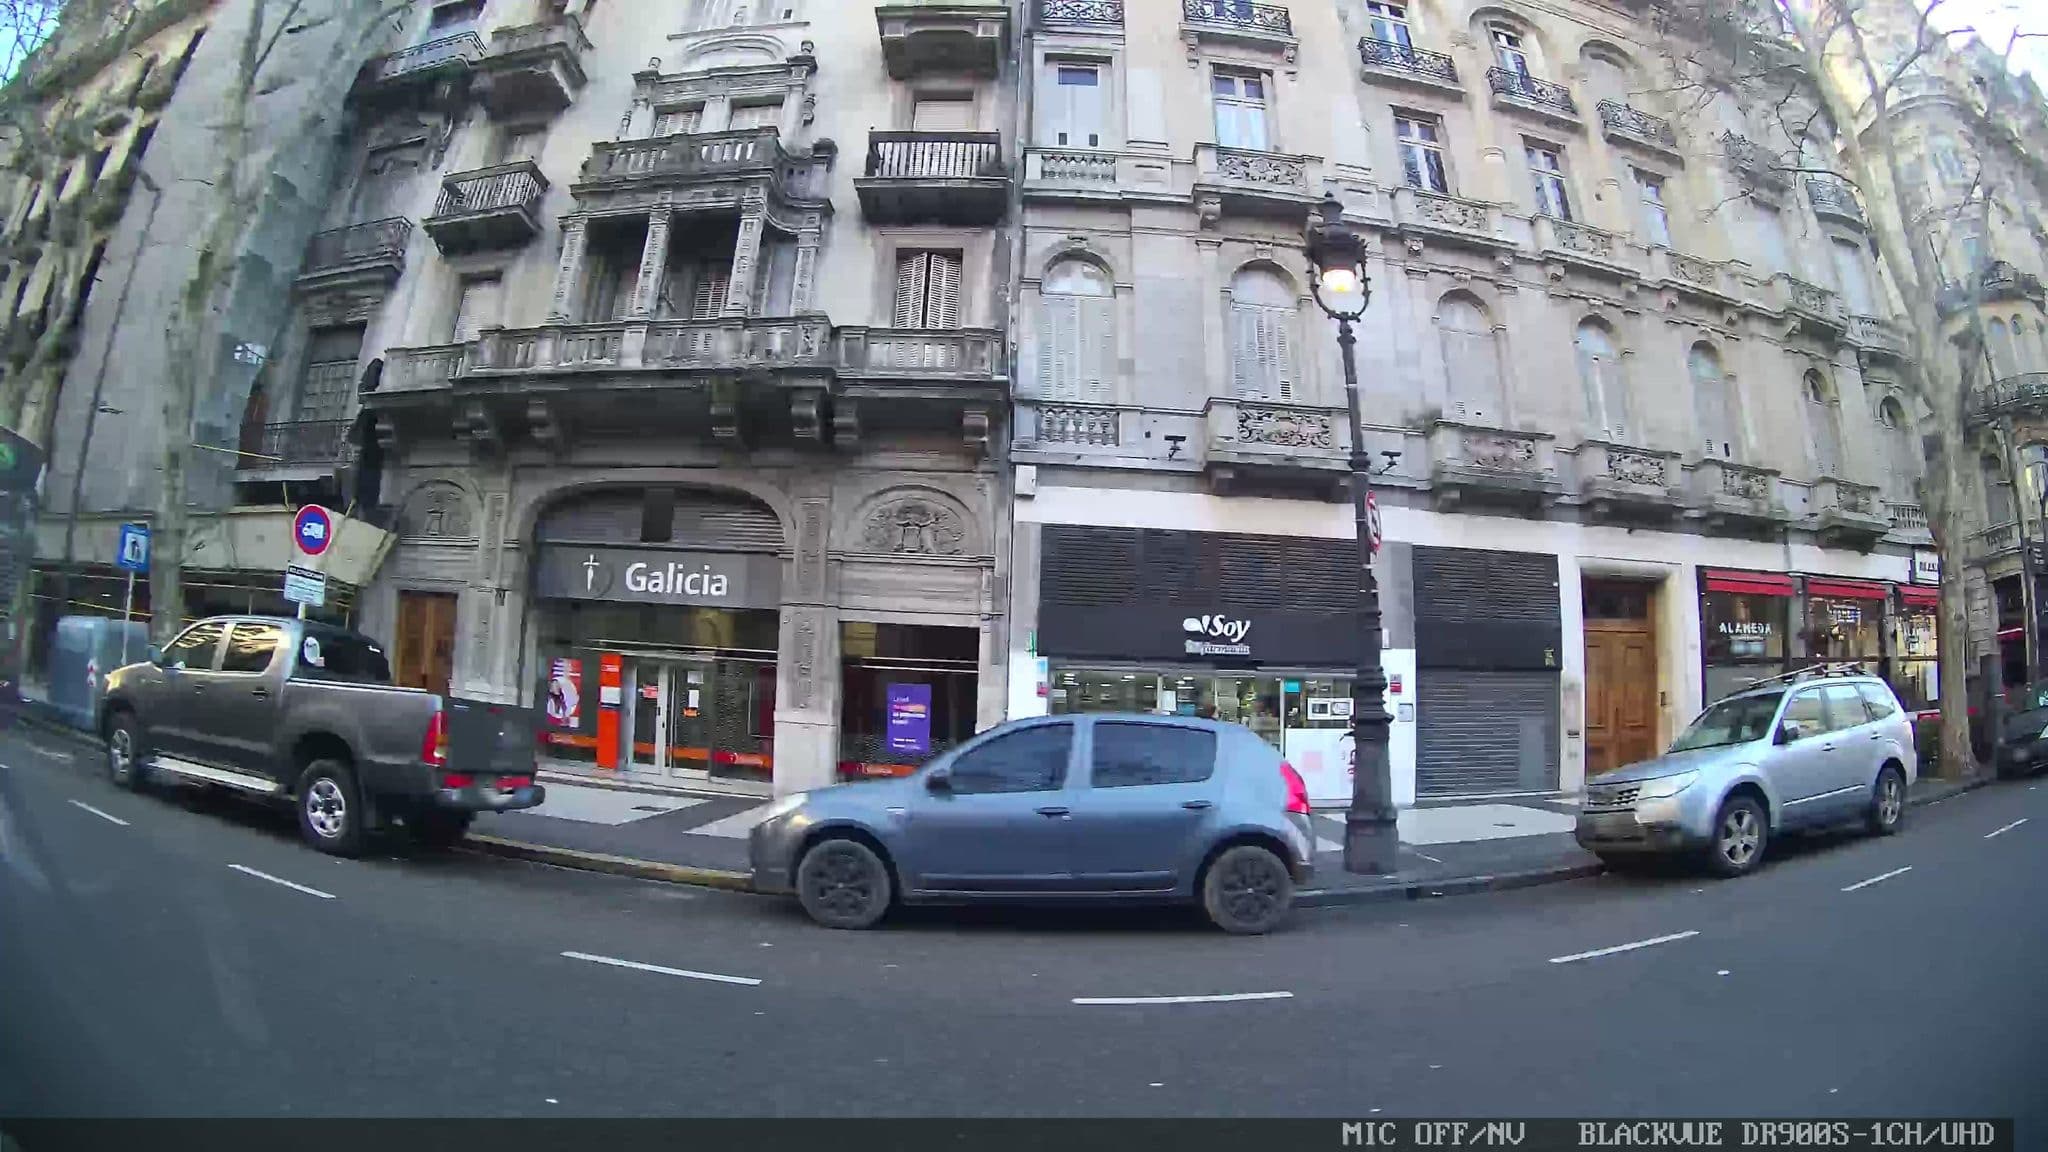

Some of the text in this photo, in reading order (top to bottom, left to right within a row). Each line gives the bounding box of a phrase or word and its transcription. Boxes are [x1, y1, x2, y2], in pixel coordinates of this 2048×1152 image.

[626, 562, 728, 596] Galicia
[1209, 615, 1251, 642] Soy
[1719, 622, 1772, 634] ALAMEDA
